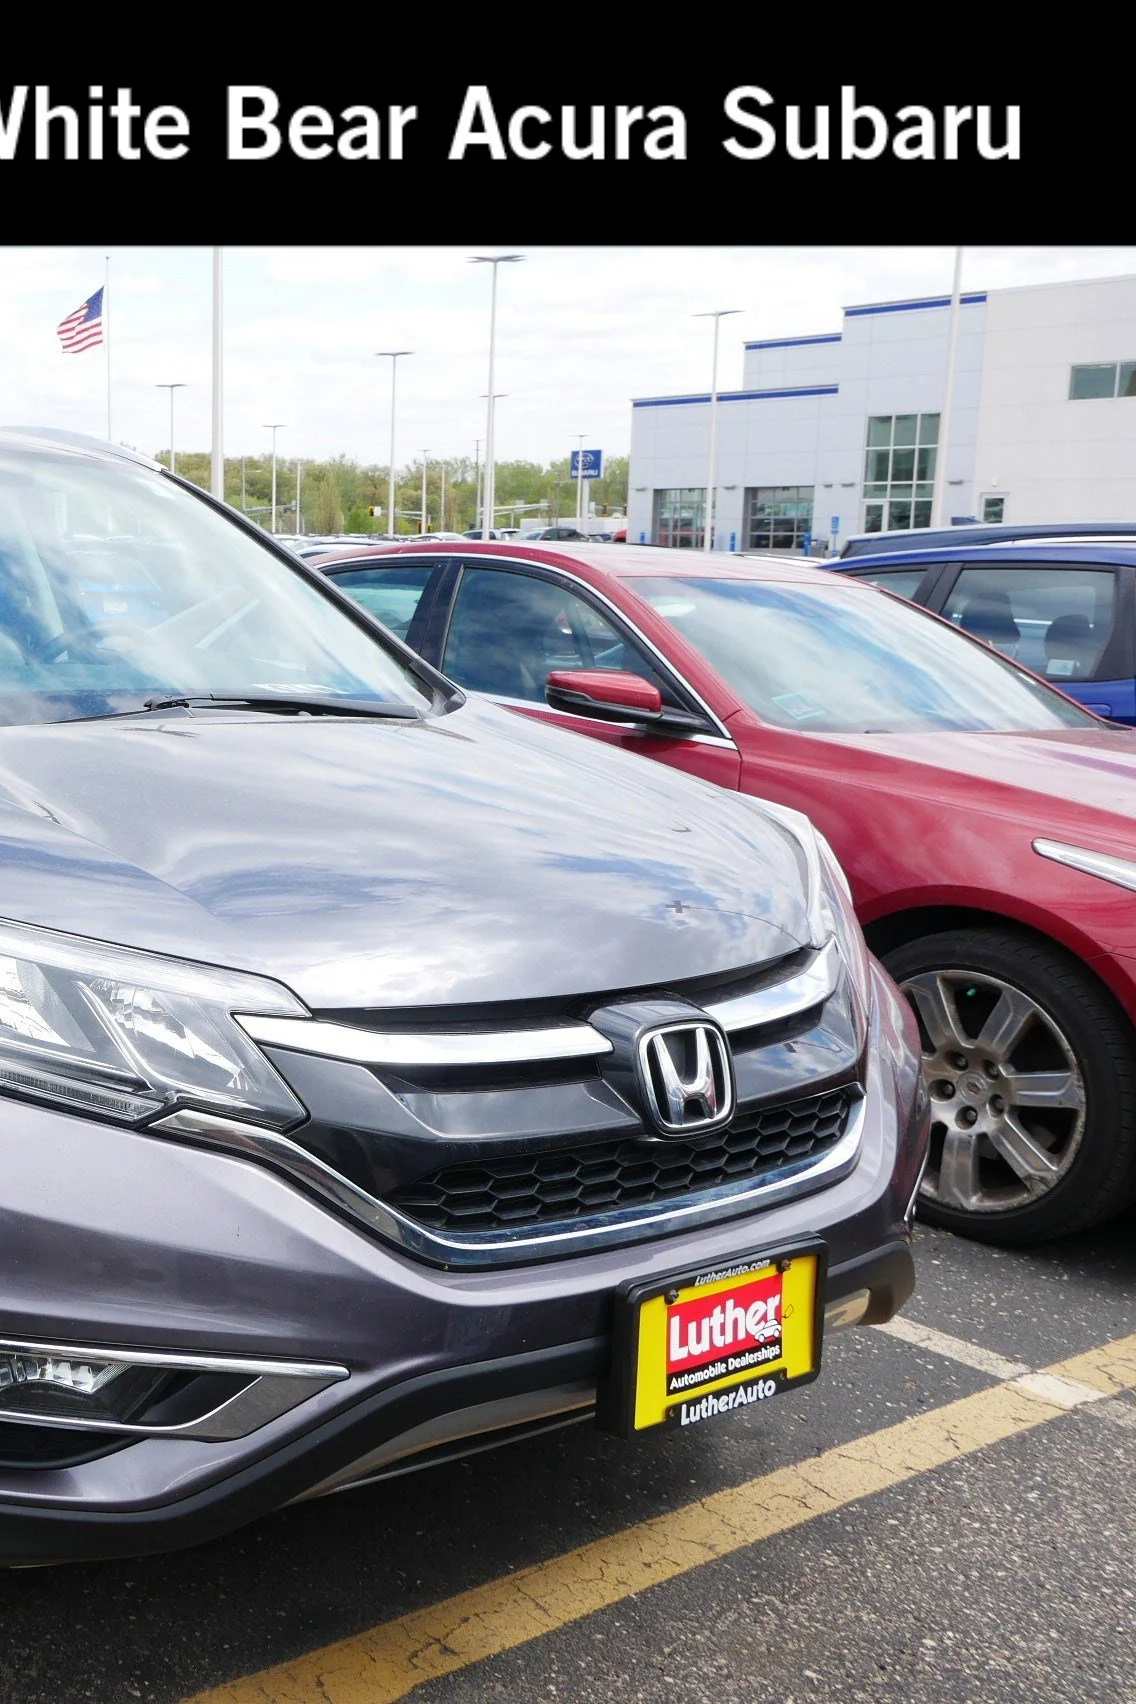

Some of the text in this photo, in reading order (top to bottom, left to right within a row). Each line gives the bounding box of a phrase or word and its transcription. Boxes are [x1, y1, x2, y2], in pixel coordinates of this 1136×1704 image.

[571, 469, 598, 477] SUARU
[694, 1259, 770, 1286] LutherAuto.com
[669, 1294, 781, 1362] Luther
[669, 1344, 780, 1390] Automobile Dealerships
[680, 1379, 776, 1426] LutherAuto
